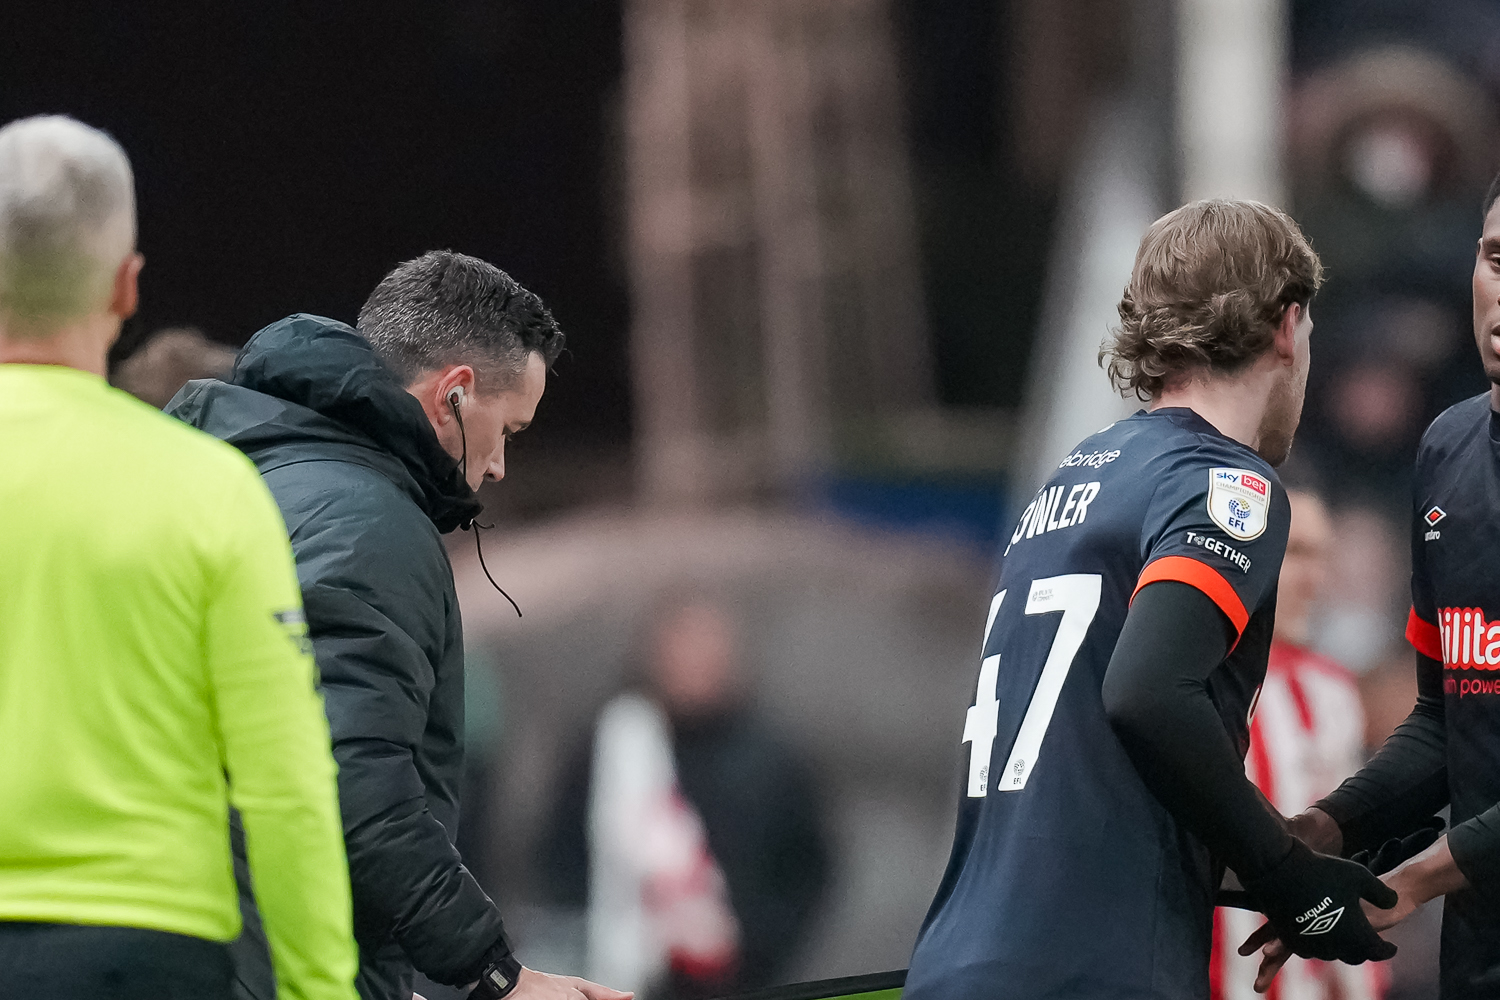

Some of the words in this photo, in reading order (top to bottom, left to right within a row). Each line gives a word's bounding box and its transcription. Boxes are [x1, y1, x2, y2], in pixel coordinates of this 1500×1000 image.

[1216, 472, 1239, 483] sky
[1243, 475, 1264, 492] bet
[1216, 481, 1265, 502] CHAMPIONSHIP
[1228, 517, 1246, 532] EFL
[962, 573, 1102, 798] 47
[1295, 896, 1333, 924] umbro
